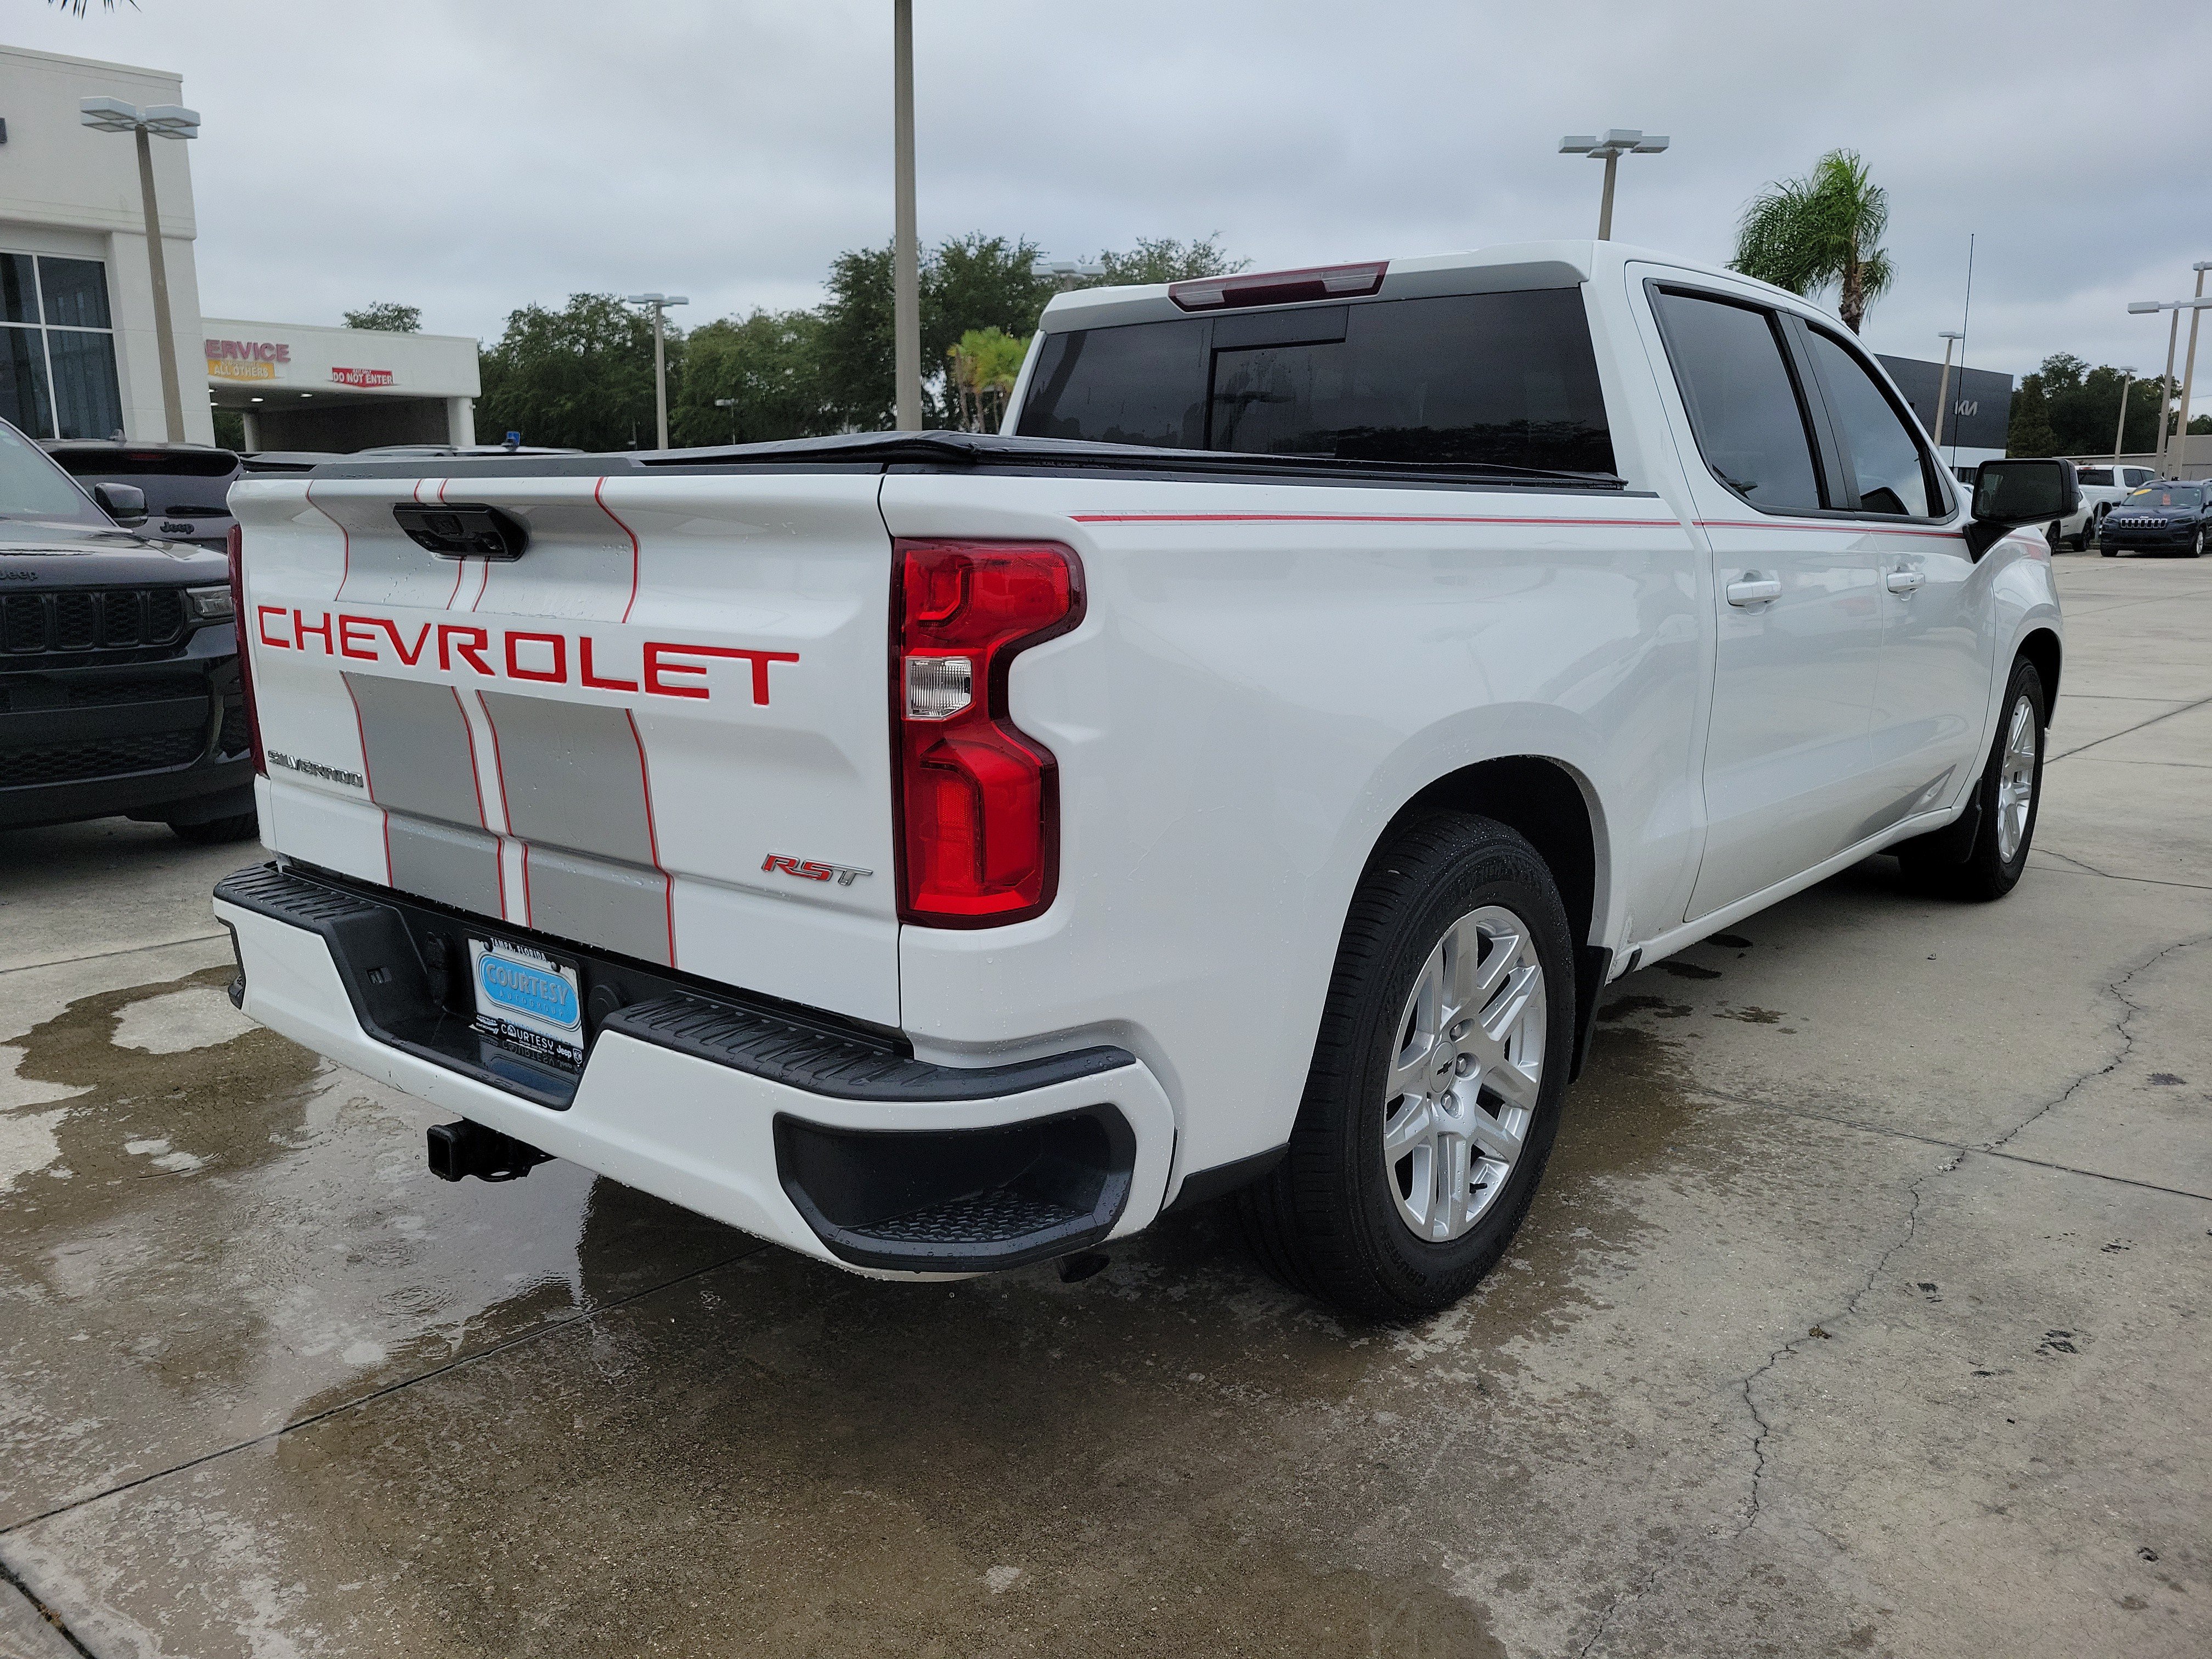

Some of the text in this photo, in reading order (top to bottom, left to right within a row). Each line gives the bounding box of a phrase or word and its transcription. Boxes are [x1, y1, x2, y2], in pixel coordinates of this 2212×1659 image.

[205, 339, 291, 363] ERVICE
[214, 364, 269, 377] ALL OTHERS
[333, 371, 393, 385] DO NOT ENTER
[160, 521, 195, 535] Jeep
[258, 605, 799, 705] CHEVROLET
[267, 749, 364, 788] SILVERADO
[761, 853, 874, 886] RST
[490, 937, 546, 961] TAMPA, FLORIDA
[486, 963, 569, 1006] COURTESY
[501, 1024, 554, 1051] COURTESY
[557, 1045, 572, 1059] Jeep
